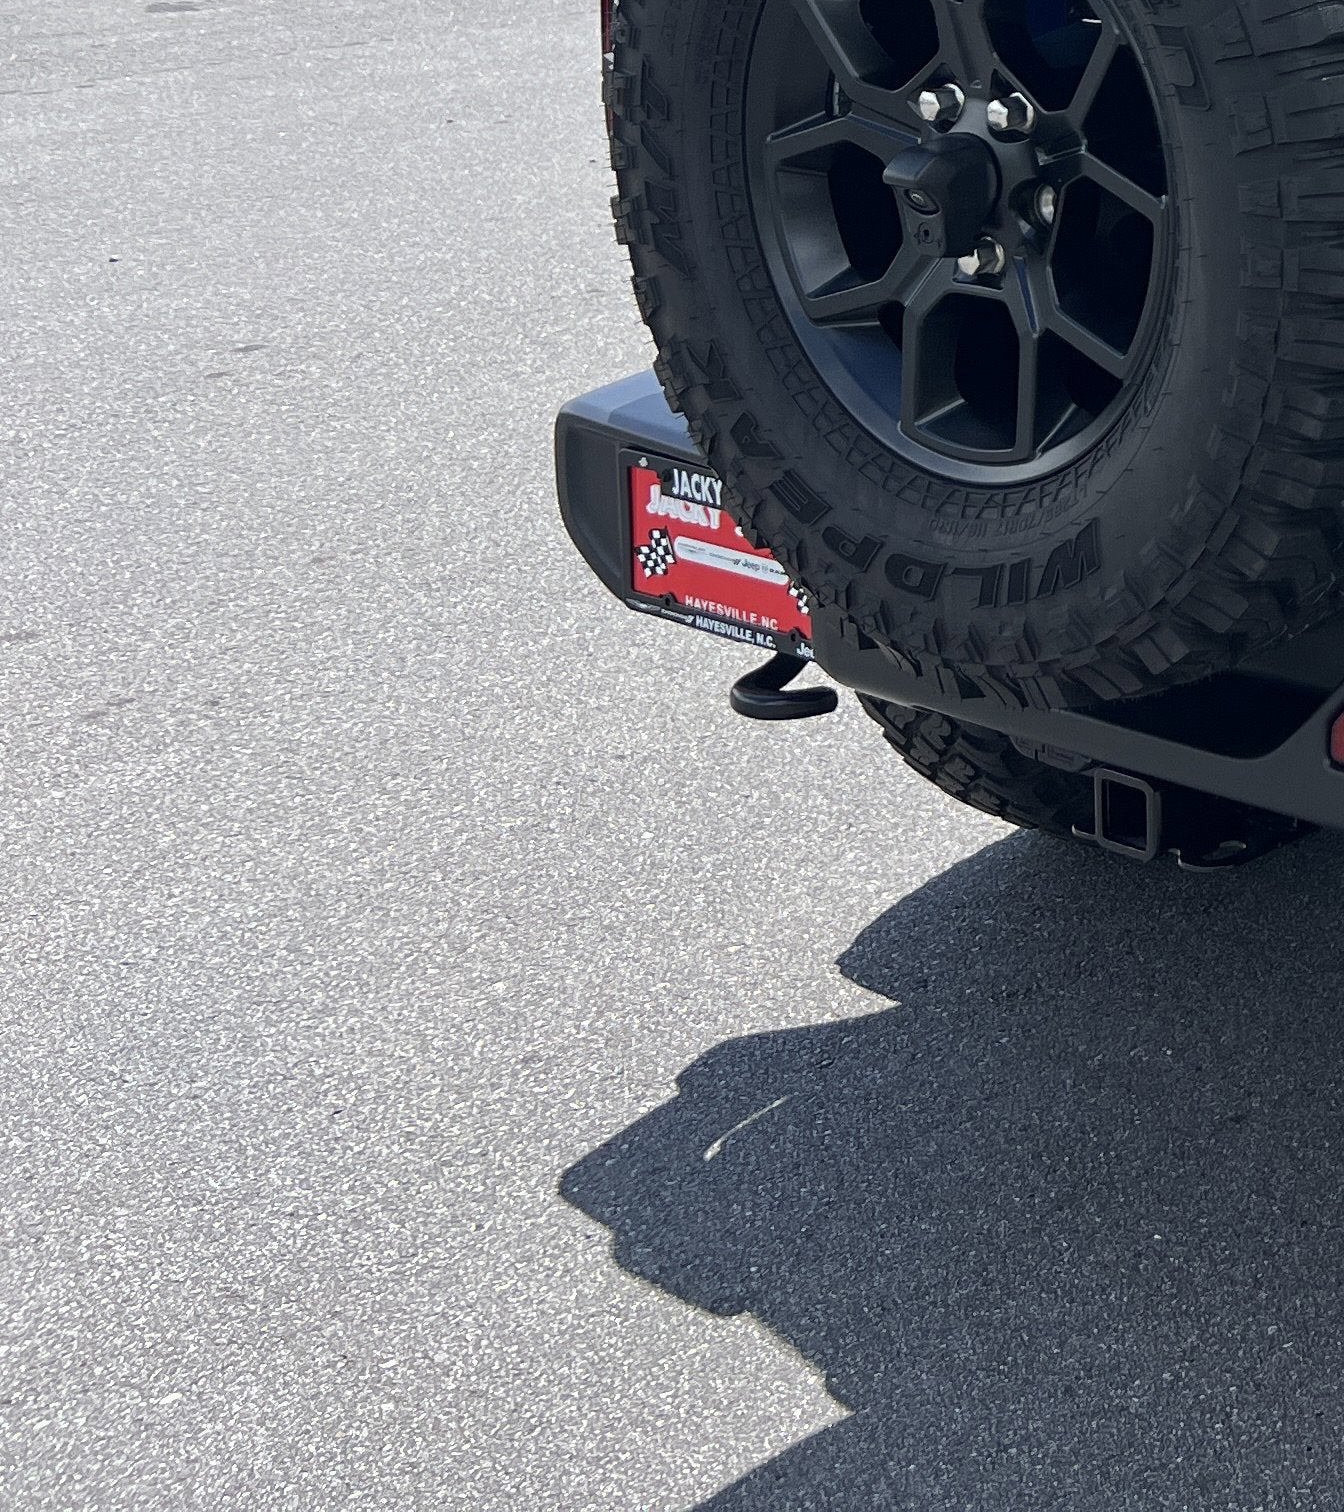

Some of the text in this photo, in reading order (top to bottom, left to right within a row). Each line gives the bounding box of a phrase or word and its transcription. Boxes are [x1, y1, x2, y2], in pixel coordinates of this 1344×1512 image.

[672, 468, 723, 505] JACKY
[686, 340, 1100, 608] WILDPEAK
[695, 615, 755, 643] HAYESVILLE,
[756, 632, 777, 648] N.C.
